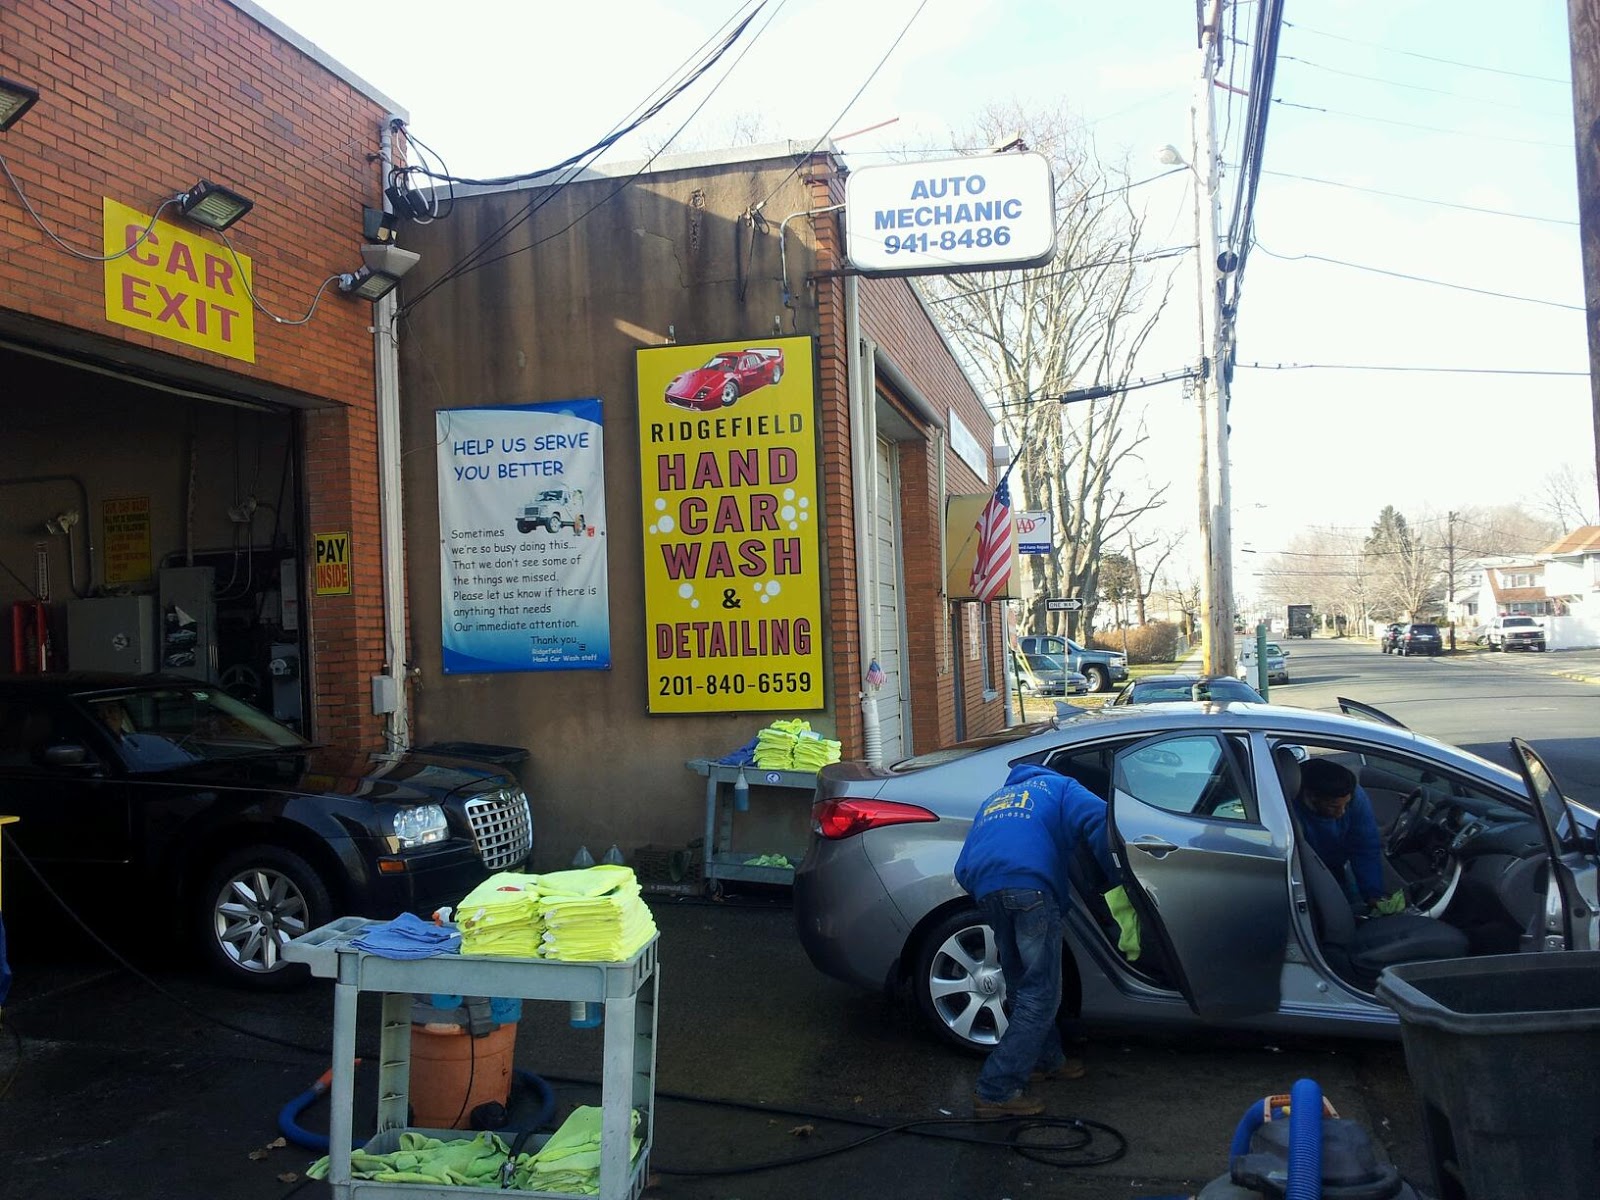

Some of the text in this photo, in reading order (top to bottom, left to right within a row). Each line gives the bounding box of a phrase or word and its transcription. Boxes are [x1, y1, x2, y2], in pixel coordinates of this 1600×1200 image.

[911, 174, 986, 200] AUTO
[874, 198, 1023, 231] MECHANIC
[884, 226, 1011, 255] 941-8486
[125, 224, 235, 297] CAR
[122, 273, 240, 342] EXIT
[651, 413, 803, 443] RIDGEFIELD
[454, 432, 589, 456] HELP US SERVE
[454, 460, 564, 481] YOU BETTER
[657, 447, 798, 491] HAND
[679, 493, 780, 536] CAR
[451, 528, 505, 539] Sometimes
[316, 538, 346, 564] PAY
[451, 544, 478, 555] we're
[480, 546, 491, 554] so
[494, 543, 517, 555] busy
[519, 541, 546, 554] doing
[660, 537, 802, 580] WASH
[453, 554, 582, 570] That we don't see some of
[317, 563, 348, 589] INSIDE
[453, 572, 559, 587] the things we missed.
[453, 585, 597, 601] Please let us know if there is
[722, 588, 741, 609] &
[453, 604, 552, 618] anything that needs
[454, 618, 579, 632] Our immediate attention.
[531, 634, 559, 645] Thank
[655, 618, 812, 659] DETAILING
[550, 655, 561, 663] Car
[563, 654, 580, 662] Wash
[659, 671, 812, 696] 201-840-6559
